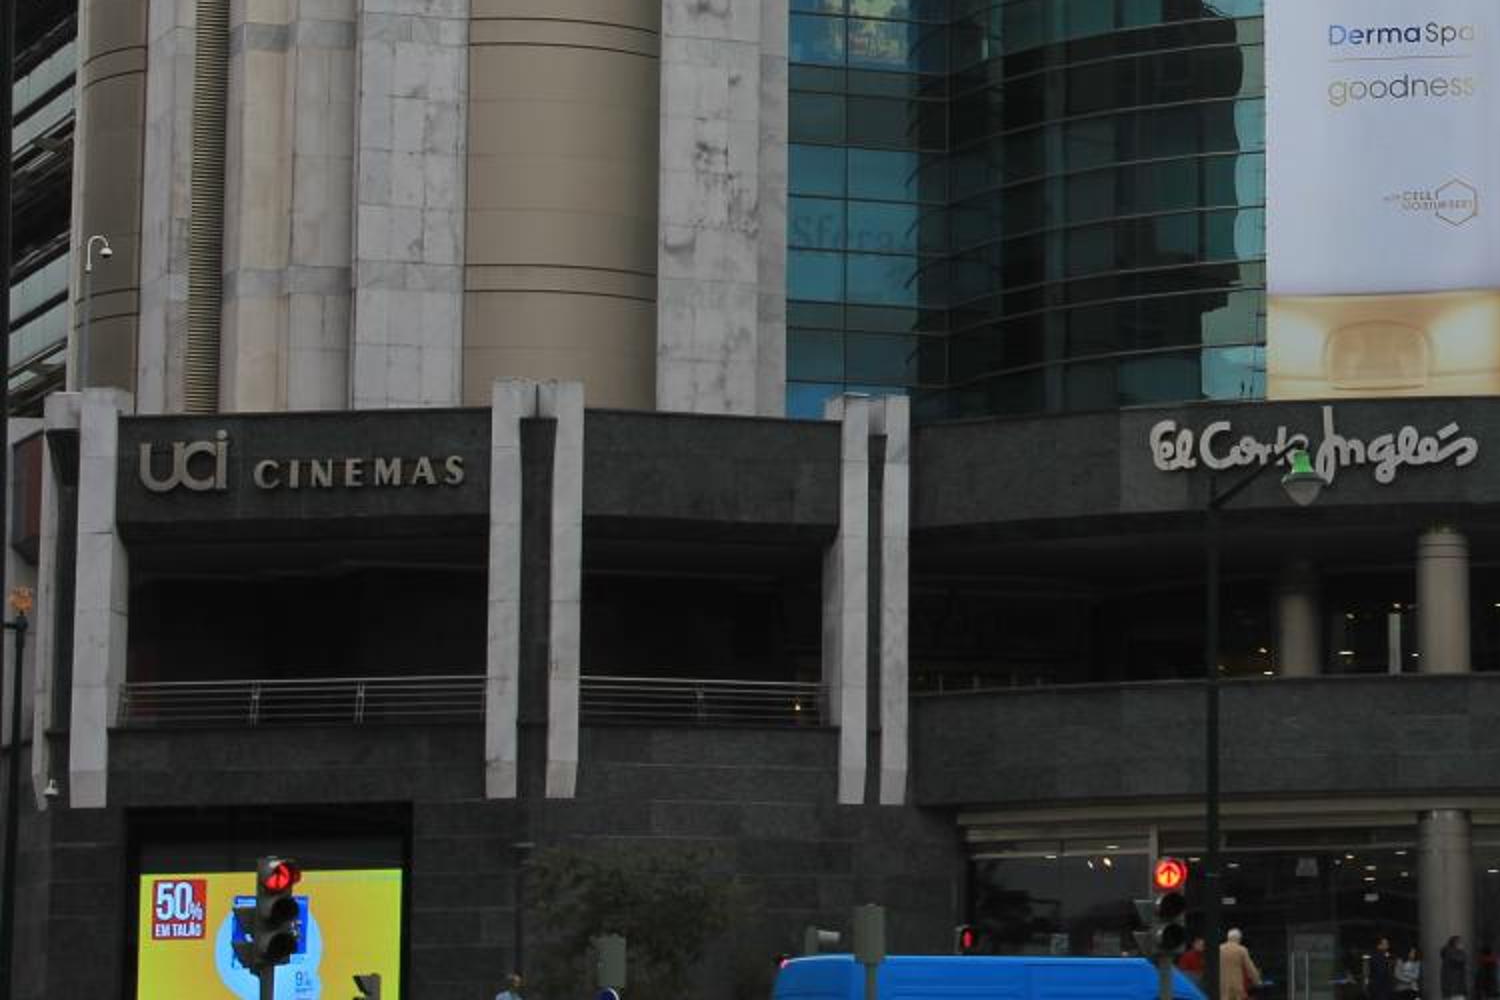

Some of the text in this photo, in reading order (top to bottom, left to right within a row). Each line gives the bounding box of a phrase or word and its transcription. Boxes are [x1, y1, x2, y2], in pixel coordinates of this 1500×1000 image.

[1328, 74, 1475, 106] goodness
[138, 429, 465, 492] uci CINEMAS
[1150, 420, 1196, 471] El
[1315, 406, 1479, 485] Inglés
[155, 881, 203, 921] 50%
[155, 923, 171, 937] EM
